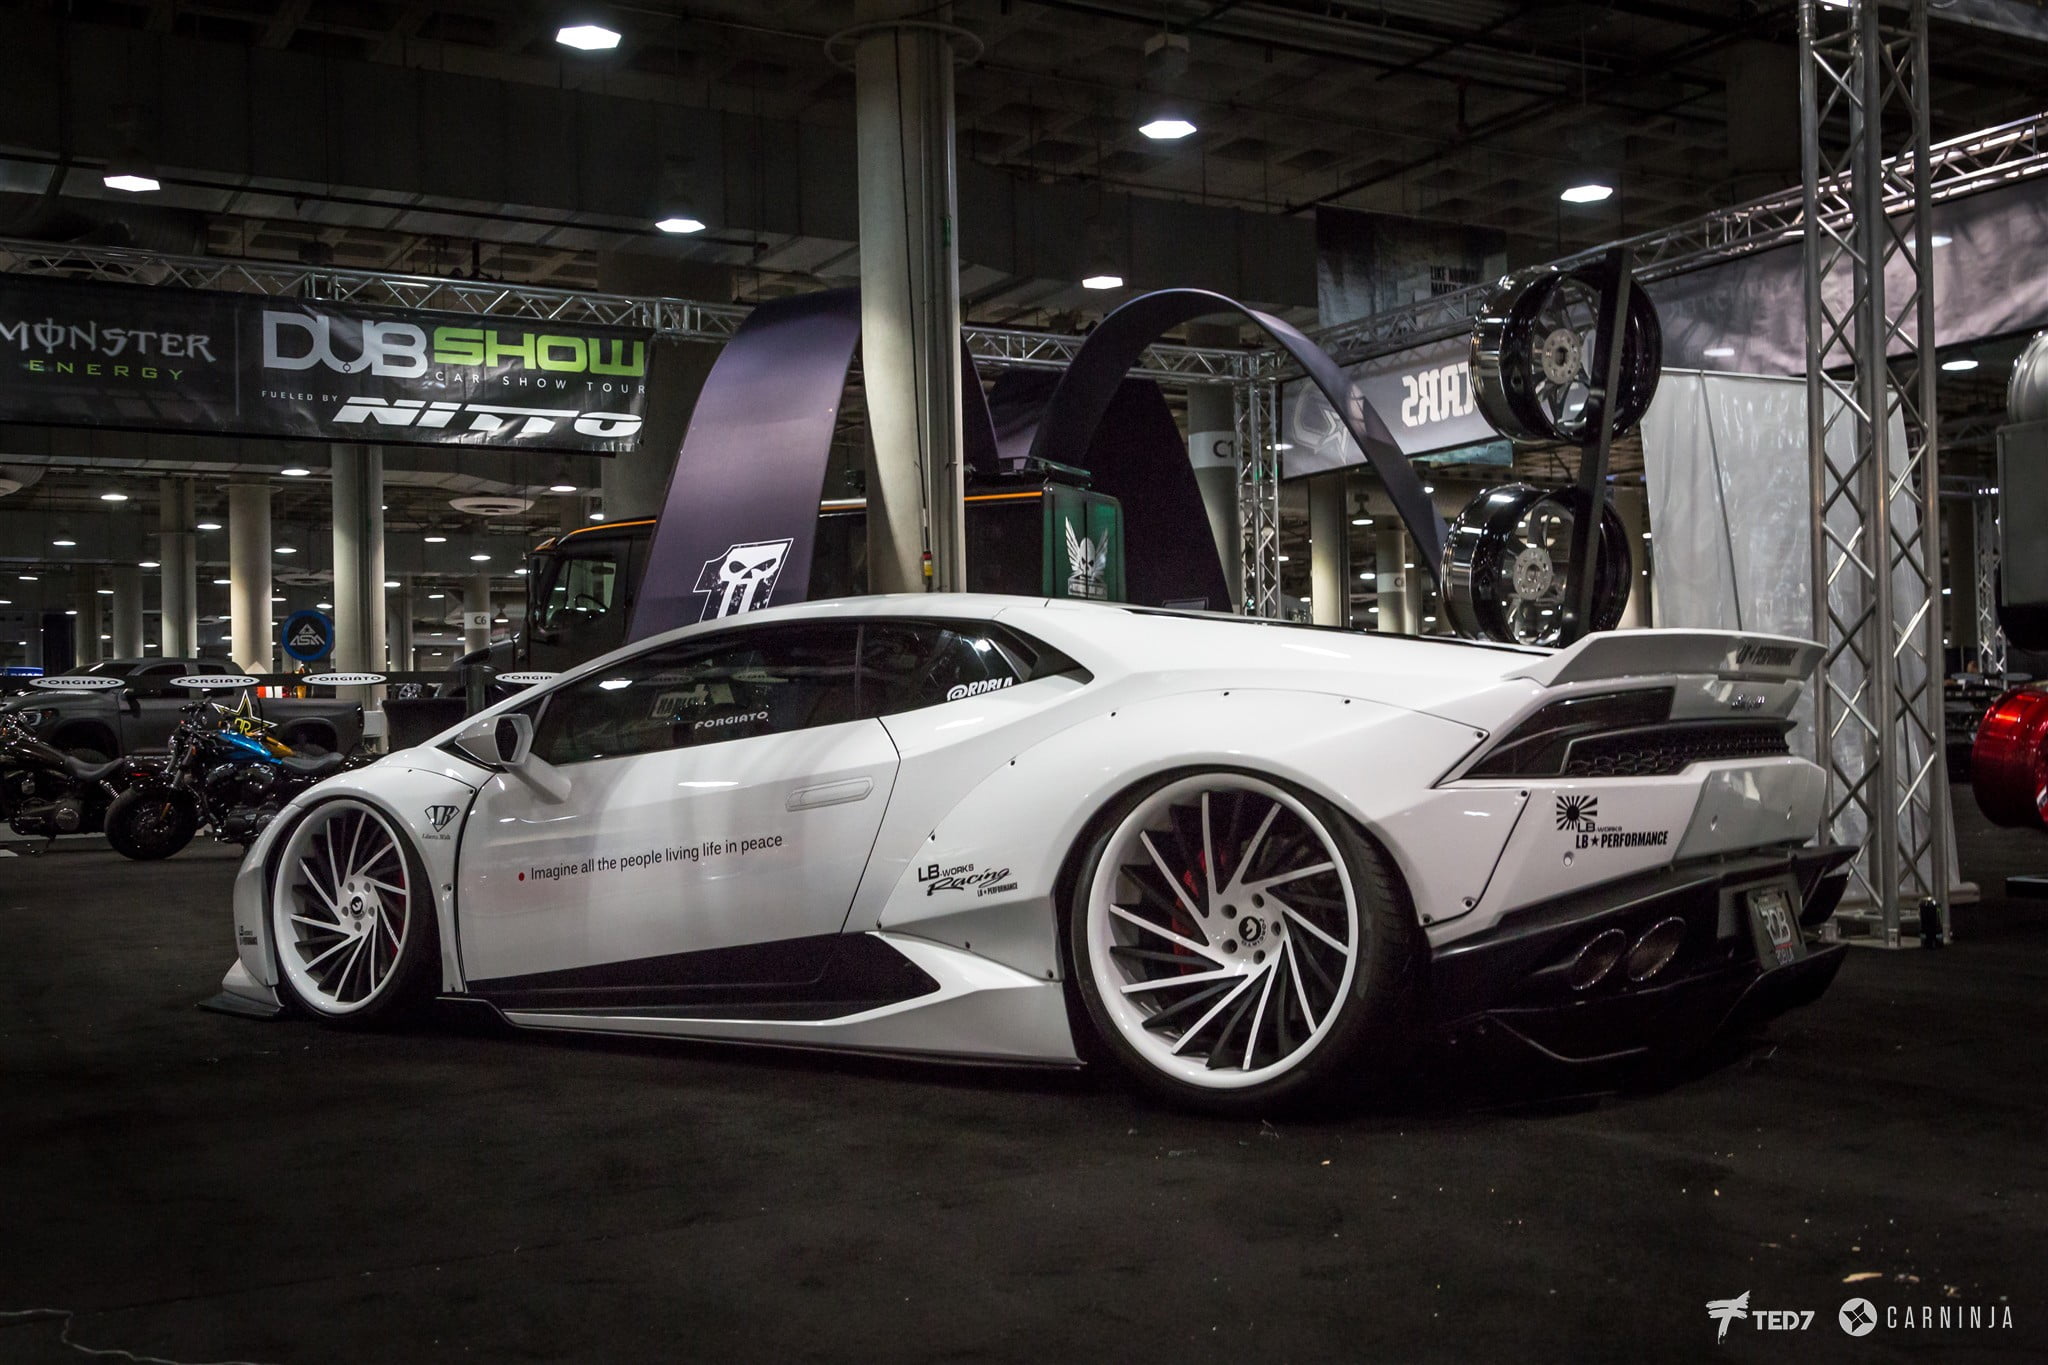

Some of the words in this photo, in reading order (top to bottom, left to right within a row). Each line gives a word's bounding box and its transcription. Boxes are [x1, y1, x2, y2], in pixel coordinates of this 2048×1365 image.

[0, 317, 216, 362] MONSTER
[263, 310, 427, 379] DUB
[433, 326, 645, 377] SHOW
[29, 359, 183, 380] ENERGY
[435, 372, 480, 384] CAR
[503, 375, 567, 389] SHOW
[587, 381, 647, 395] TOUR
[261, 390, 313, 401] FUELED
[322, 394, 338, 402] BY
[474, 615, 487, 625] C6
[177, 677, 254, 685] FORGIATO
[308, 674, 382, 682] FORGIATO
[695, 711, 769, 730] FORGIATO
[1575, 834, 1589, 849] LB
[1600, 831, 1669, 849] PERFORMANCE
[531, 865, 578, 881] Imagine
[581, 859, 594, 873] all
[597, 857, 617, 871] the
[620, 851, 662, 871] people
[665, 846, 699, 862] living
[703, 842, 722, 857] life
[725, 838, 737, 853] in
[741, 835, 783, 851] peace
[927, 868, 1011, 896] Racing
